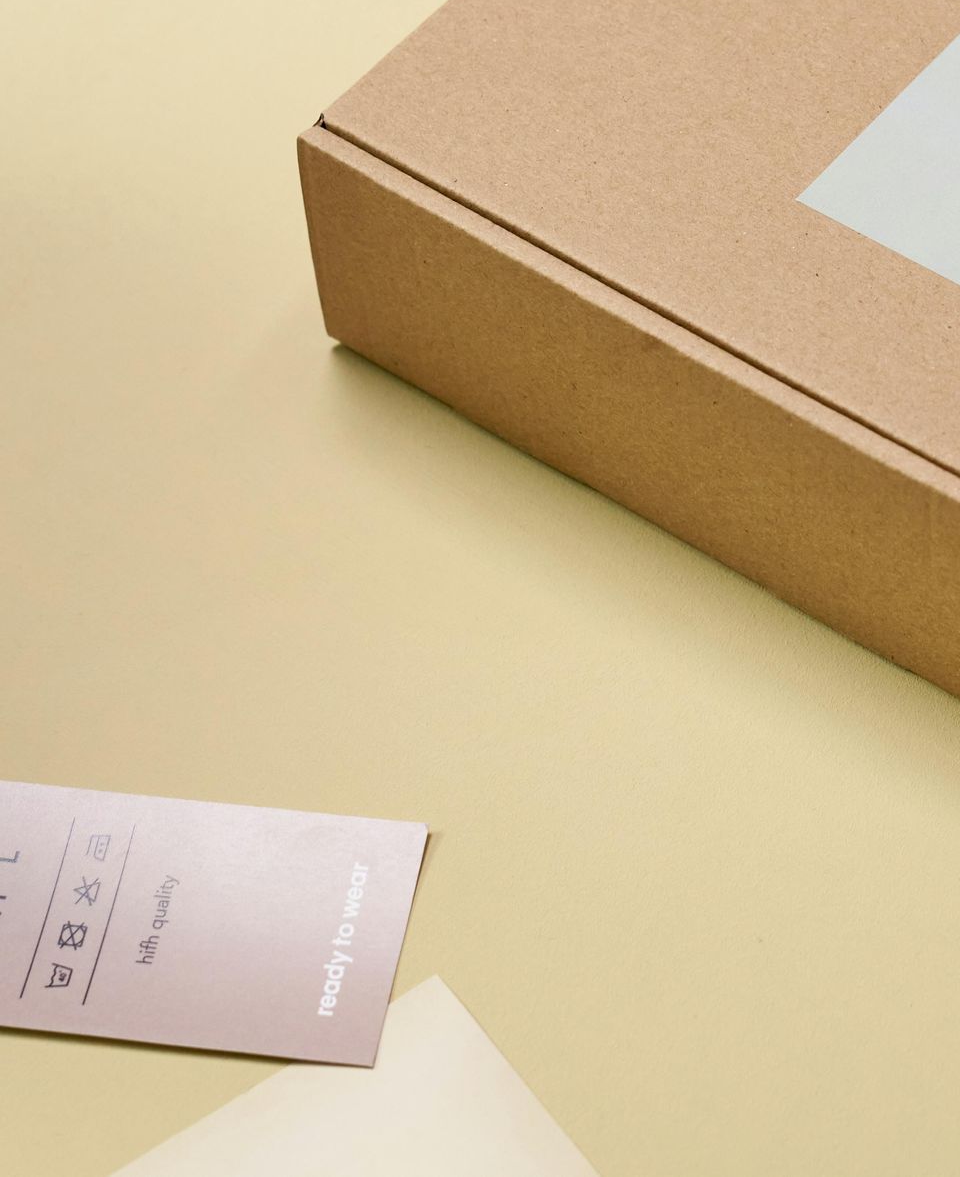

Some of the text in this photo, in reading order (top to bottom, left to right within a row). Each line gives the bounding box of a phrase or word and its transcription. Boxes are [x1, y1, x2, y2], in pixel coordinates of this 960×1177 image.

[135, 874, 180, 965] hifh quality
[317, 861, 369, 1016] ready to wear
